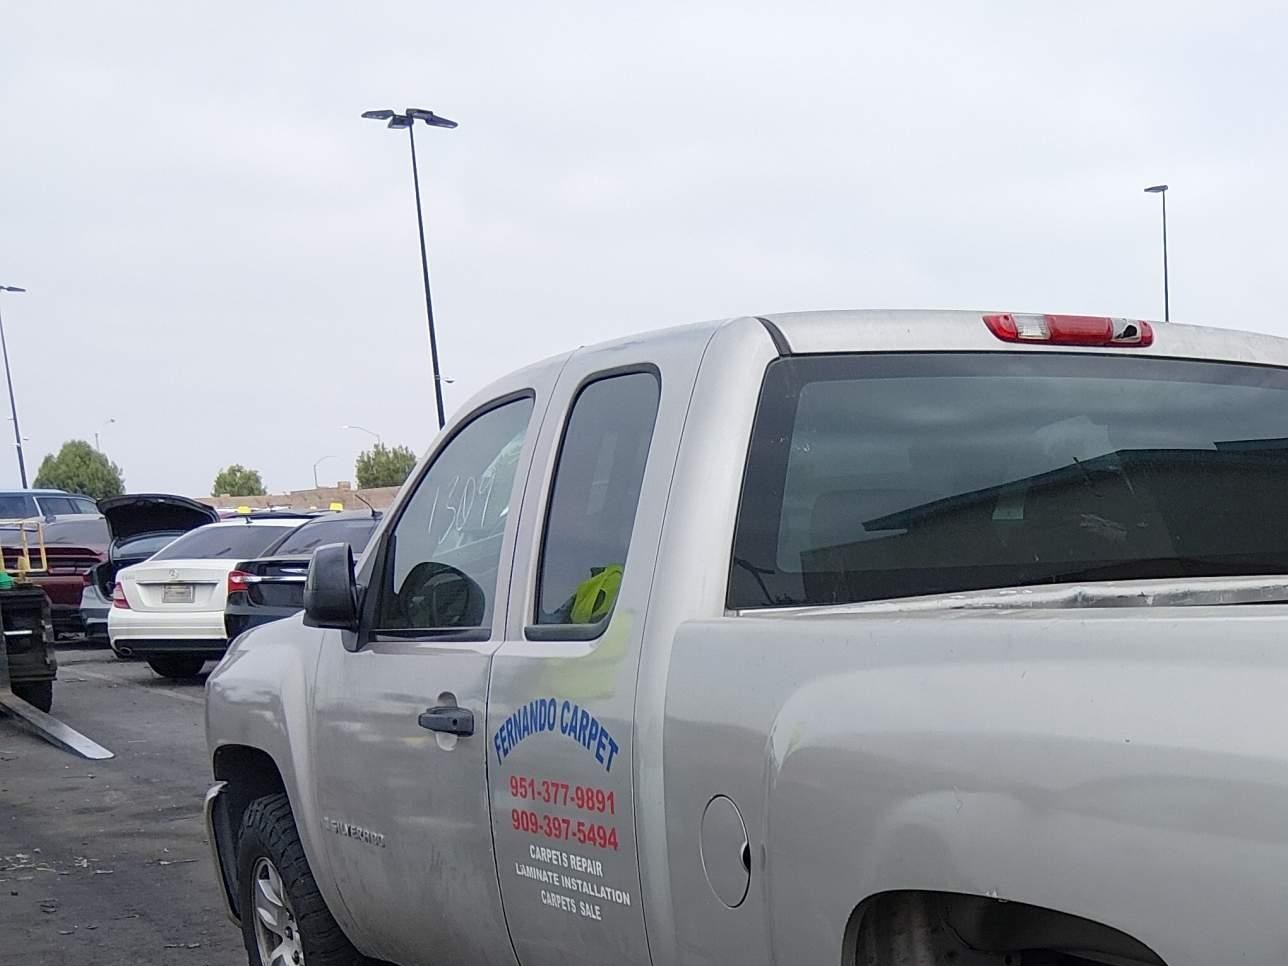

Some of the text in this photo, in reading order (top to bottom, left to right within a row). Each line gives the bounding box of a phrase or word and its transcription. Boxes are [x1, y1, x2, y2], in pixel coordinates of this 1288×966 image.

[493, 697, 619, 773] FERNANDO CARPET
[510, 775, 615, 815] 951-377-9891
[511, 808, 619, 851] 909-397-5494
[515, 862, 631, 905] LAMINATE INSTALLATION
[570, 853, 603, 877] REPAIR
[541, 889, 602, 920] CARPETS SALE
